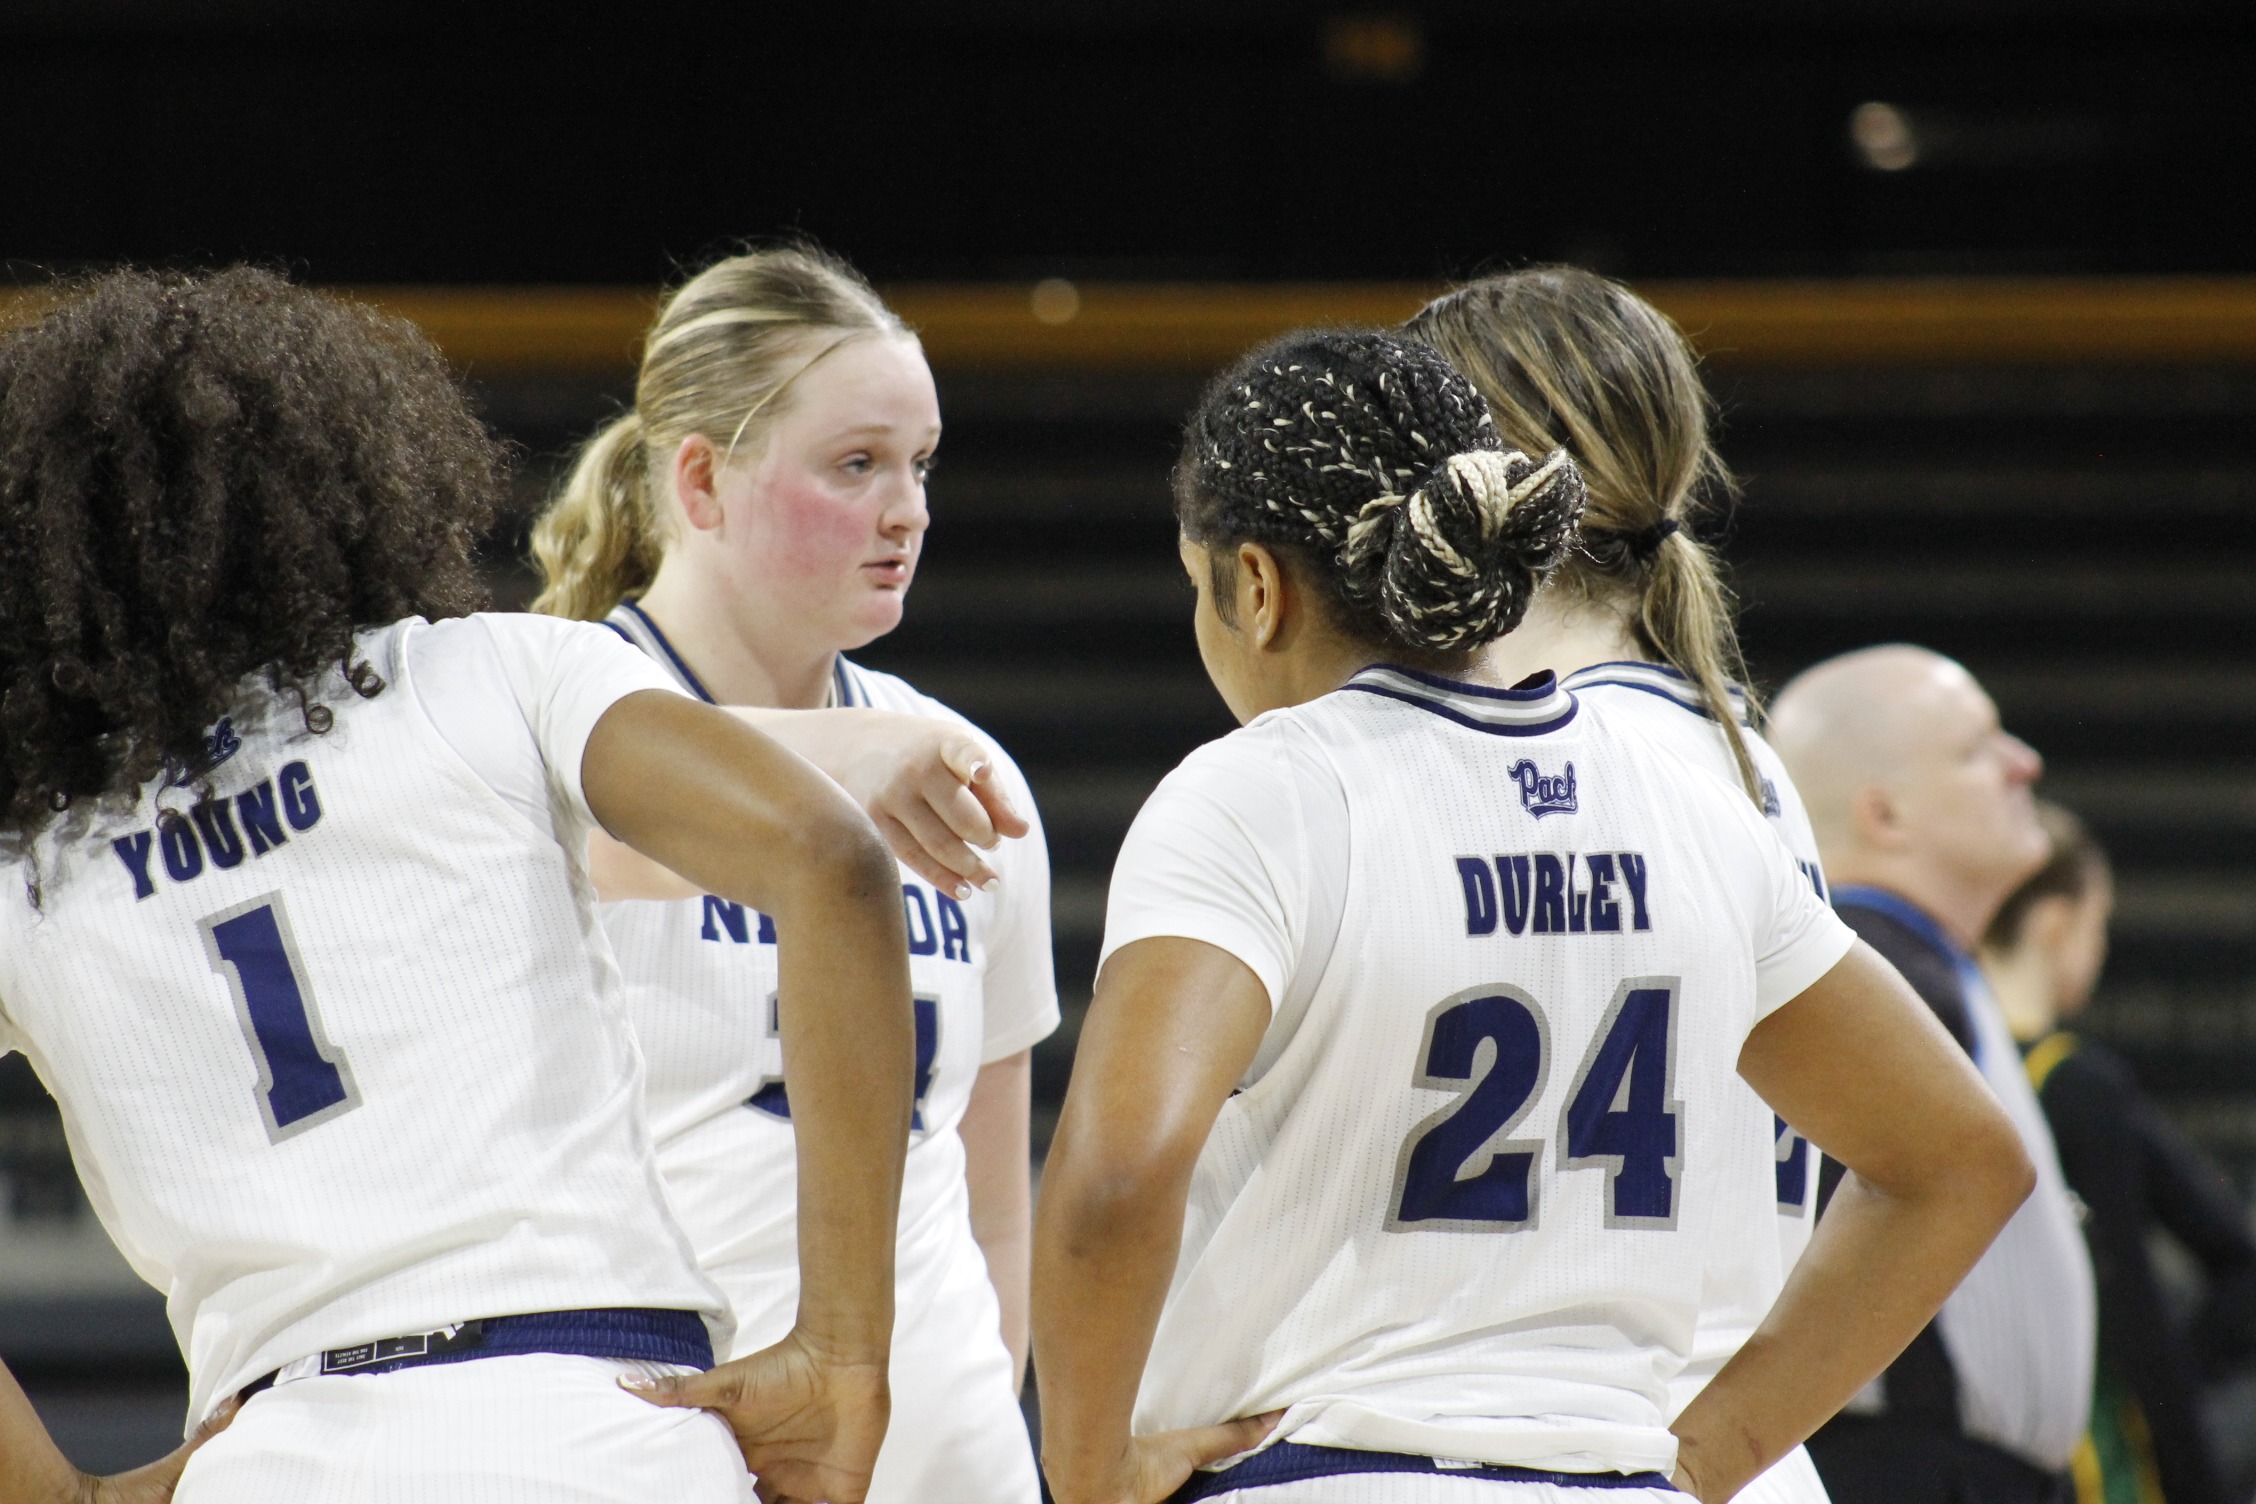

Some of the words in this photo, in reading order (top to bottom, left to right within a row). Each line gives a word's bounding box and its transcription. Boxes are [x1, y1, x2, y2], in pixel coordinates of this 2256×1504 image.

[110, 759, 324, 902] YOUNG
[1507, 758, 1578, 818] Pack
[701, 883, 972, 964] NDA
[1452, 851, 1654, 938] DURLEY
[195, 889, 364, 1146] 1
[1381, 975, 1686, 1234] 24
